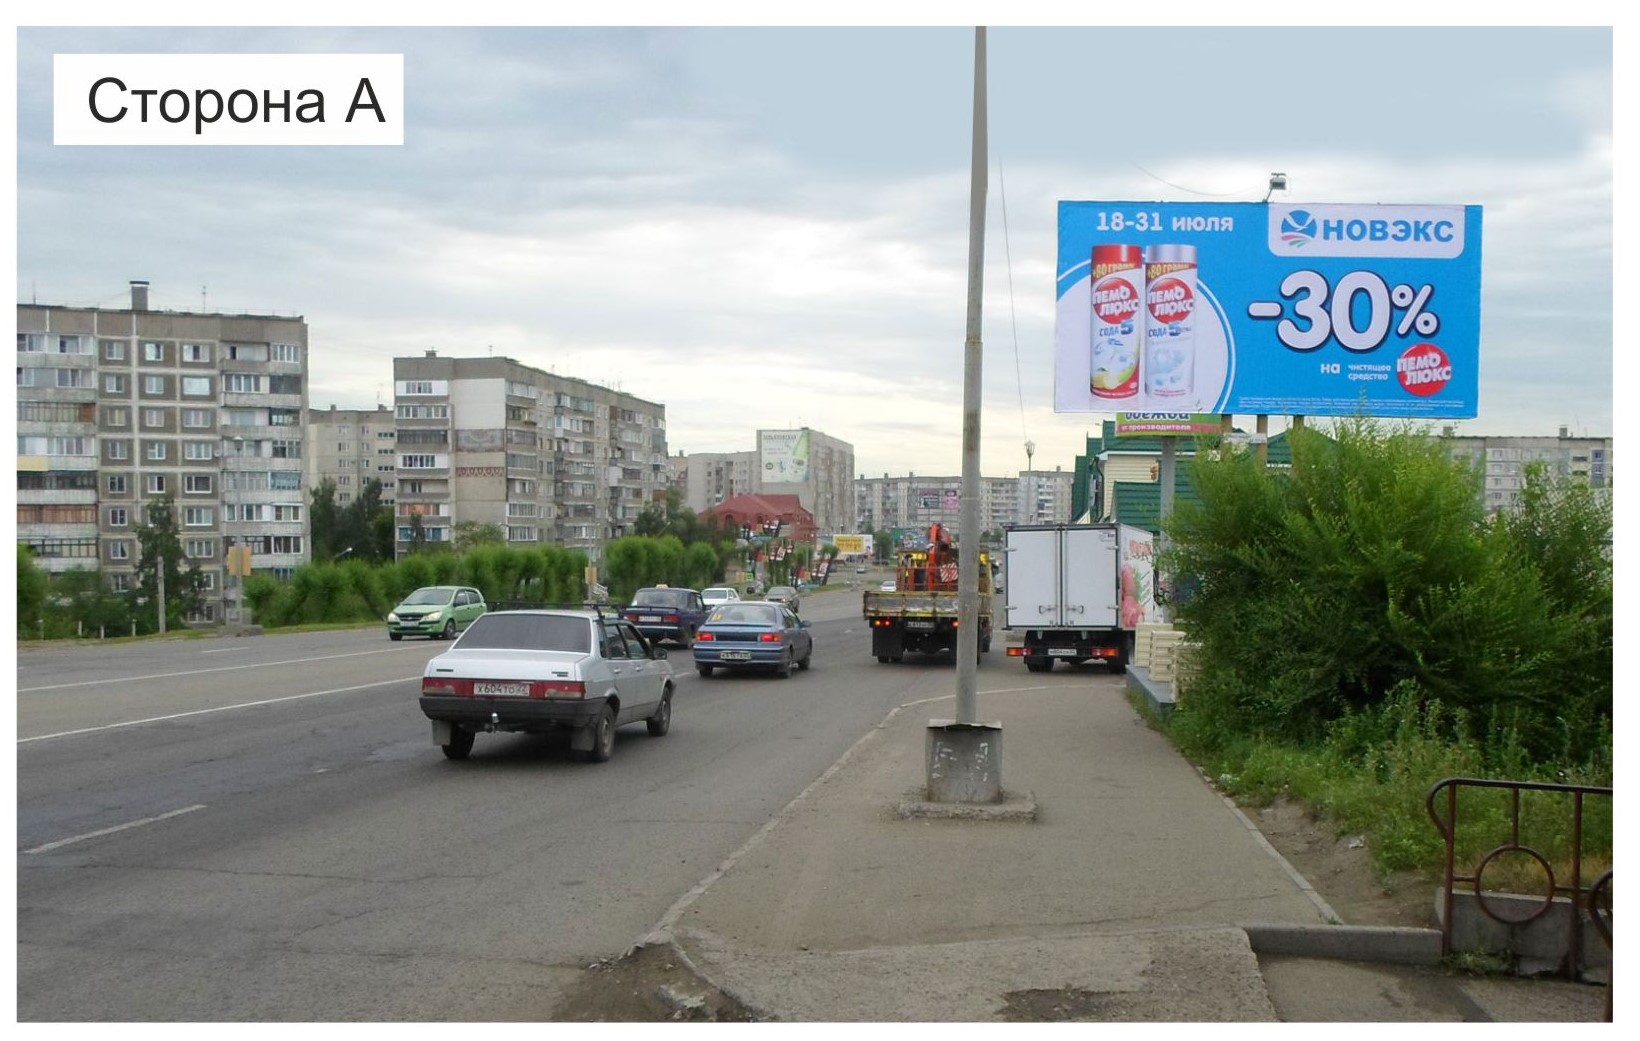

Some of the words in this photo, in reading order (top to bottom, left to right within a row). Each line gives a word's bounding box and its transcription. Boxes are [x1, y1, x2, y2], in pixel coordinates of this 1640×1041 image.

[1096, 211, 1164, 232] 18-31
[1172, 216, 1234, 232] июля
[1322, 218, 1454, 244] НОВЭКС
[1093, 286, 1131, 304] ПЕМО
[1148, 286, 1185, 304] ПЕМО
[1100, 300, 1140, 317] ЛЮКС
[1154, 299, 1194, 317] ЛЮКС
[1247, 269, 1440, 354] -30%
[1320, 363, 1341, 374] на
[1348, 364, 1392, 372] чистящее
[1396, 352, 1441, 372] ПЕМО
[1348, 373, 1389, 381] средство
[1405, 366, 1452, 385] ЛЮКС
